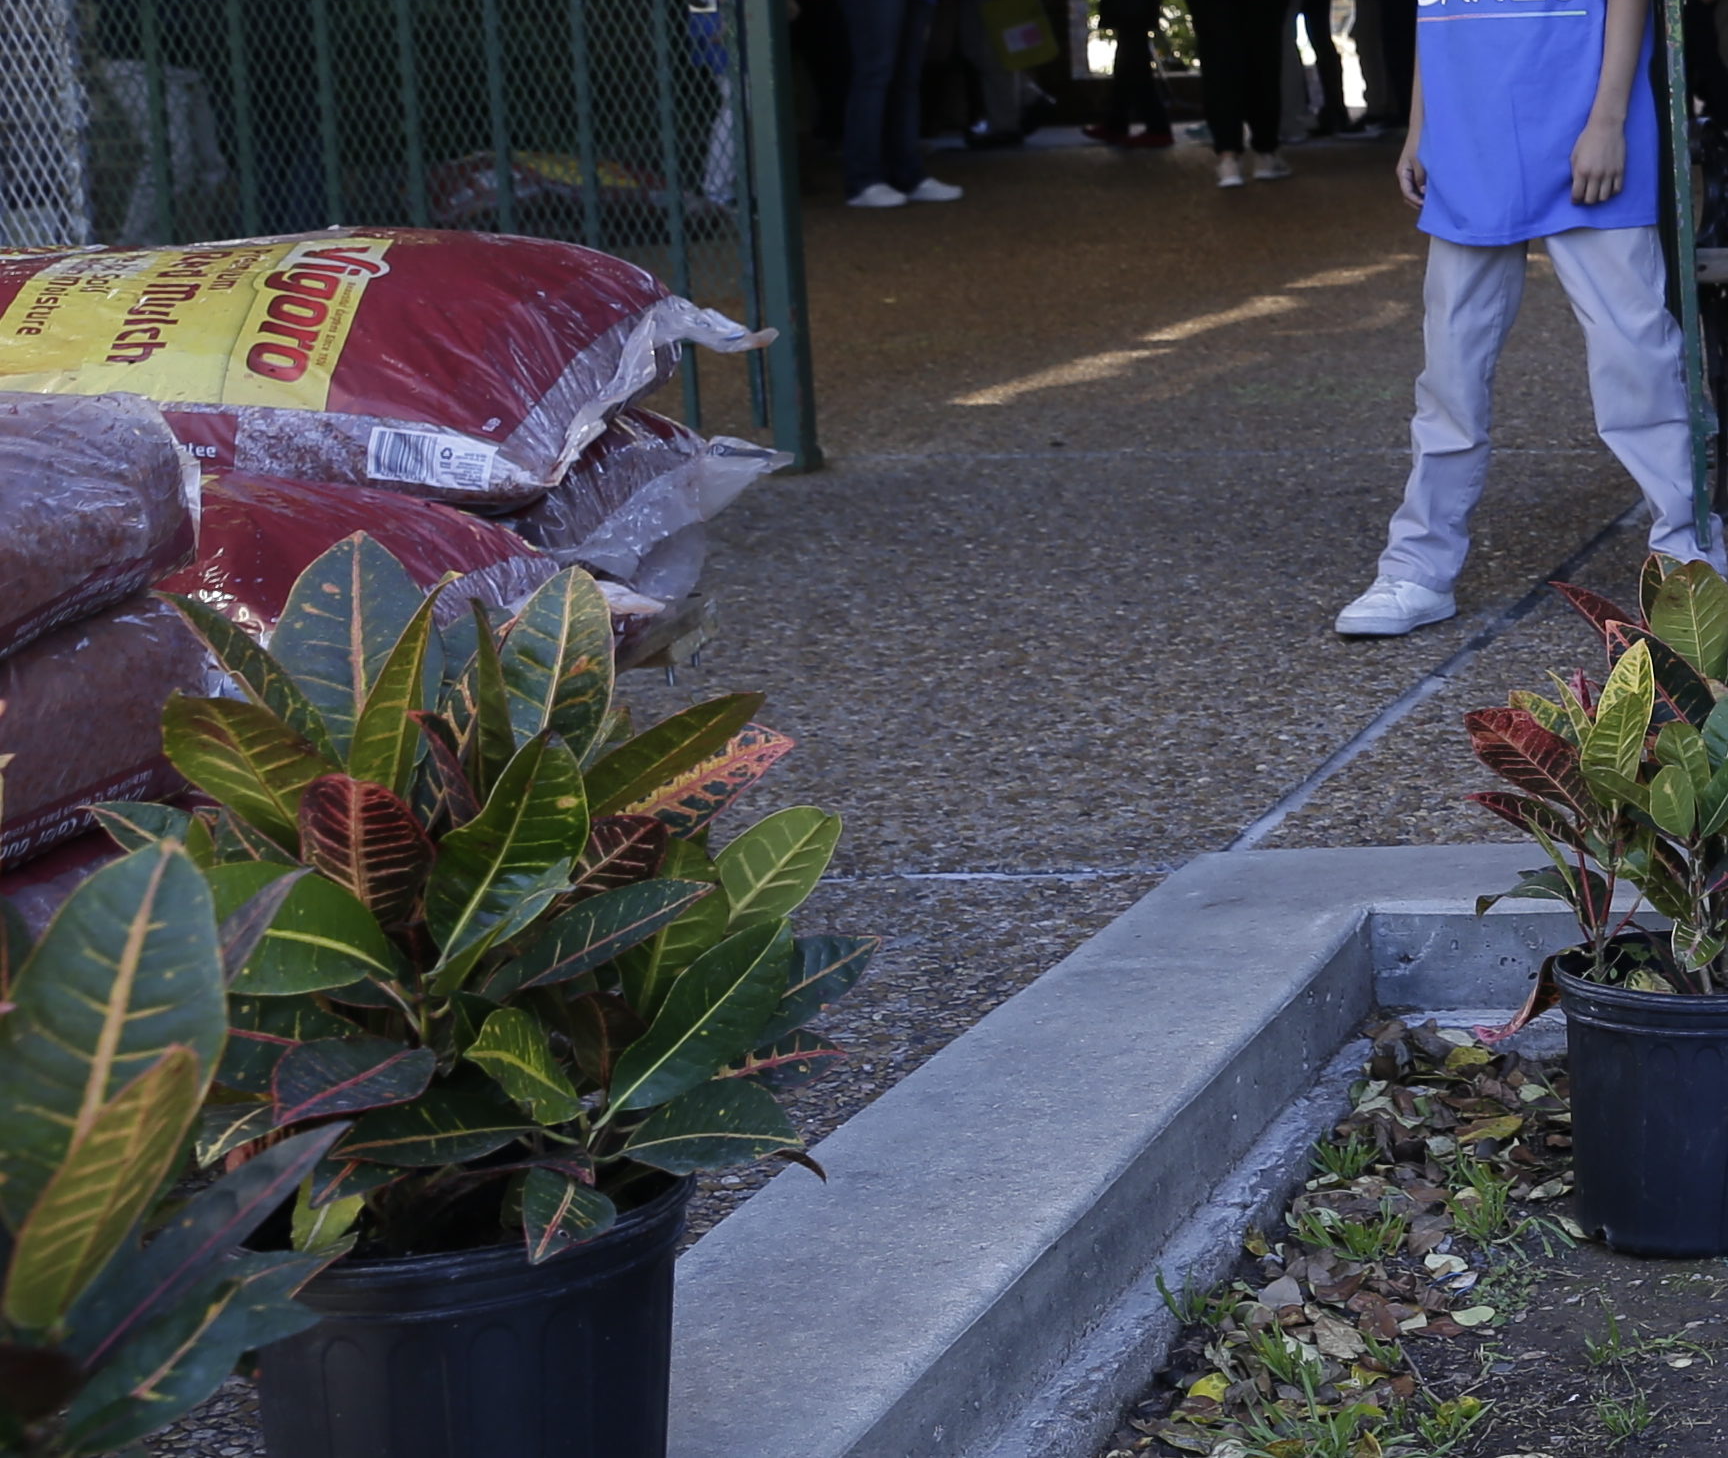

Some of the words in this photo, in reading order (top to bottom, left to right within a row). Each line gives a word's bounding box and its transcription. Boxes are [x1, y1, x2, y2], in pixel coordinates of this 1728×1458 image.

[79, 273, 122, 294] Soil
[155, 250, 234, 279] Red
[16, 276, 83, 336] Moisture
[105, 282, 198, 364] Mulch
[246, 245, 380, 383] Vigoro
